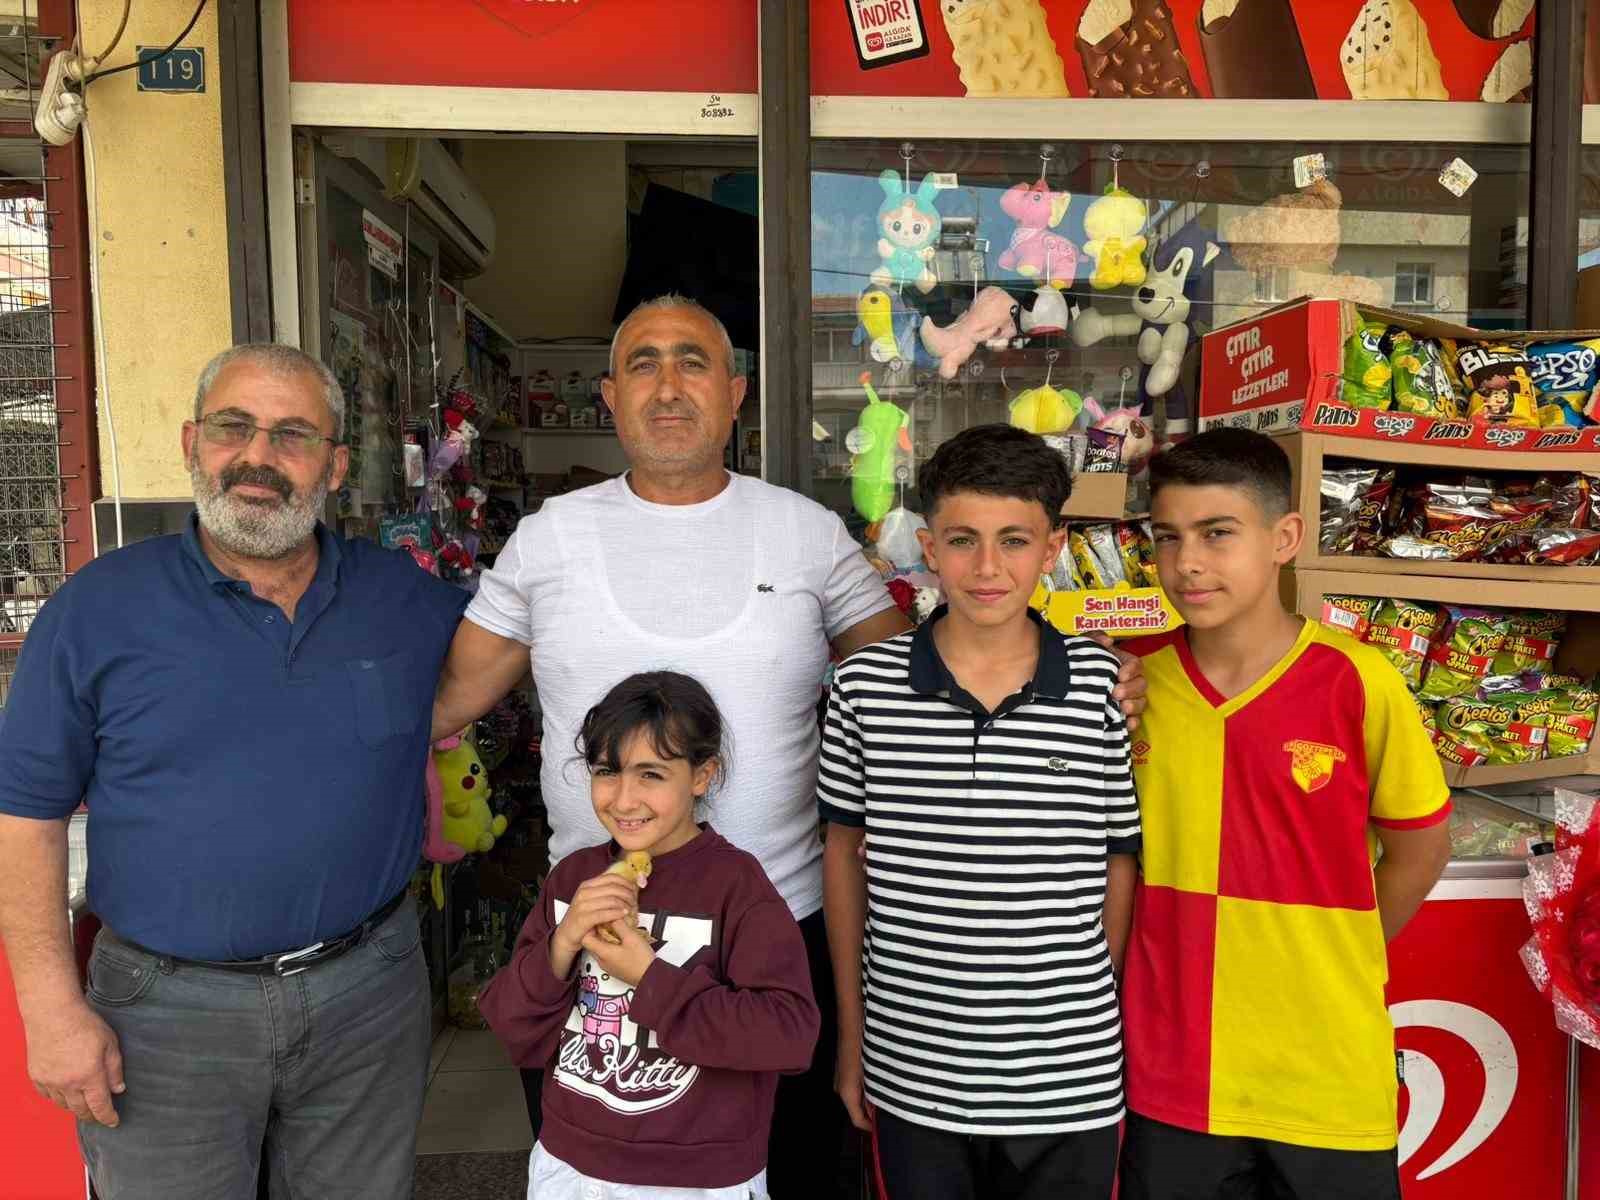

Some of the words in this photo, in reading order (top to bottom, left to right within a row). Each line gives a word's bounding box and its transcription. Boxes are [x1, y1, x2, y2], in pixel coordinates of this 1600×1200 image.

[151, 58, 193, 80] 119
[1226, 326, 1261, 365] ÇITIR
[1241, 345, 1274, 384] ÇITIR
[1232, 368, 1289, 406] LEZZETLER!
[1085, 597, 1113, 612] Sen
[1116, 595, 1160, 614] Hangi
[1074, 610, 1168, 631] Karaktersin?
[1376, 634, 1401, 647] PAKET
[1455, 659, 1480, 674] PAKET
[1447, 704, 1513, 730] Cheetos
[1554, 721, 1580, 735] PAKET
[592, 1032, 701, 1092] Kitty
